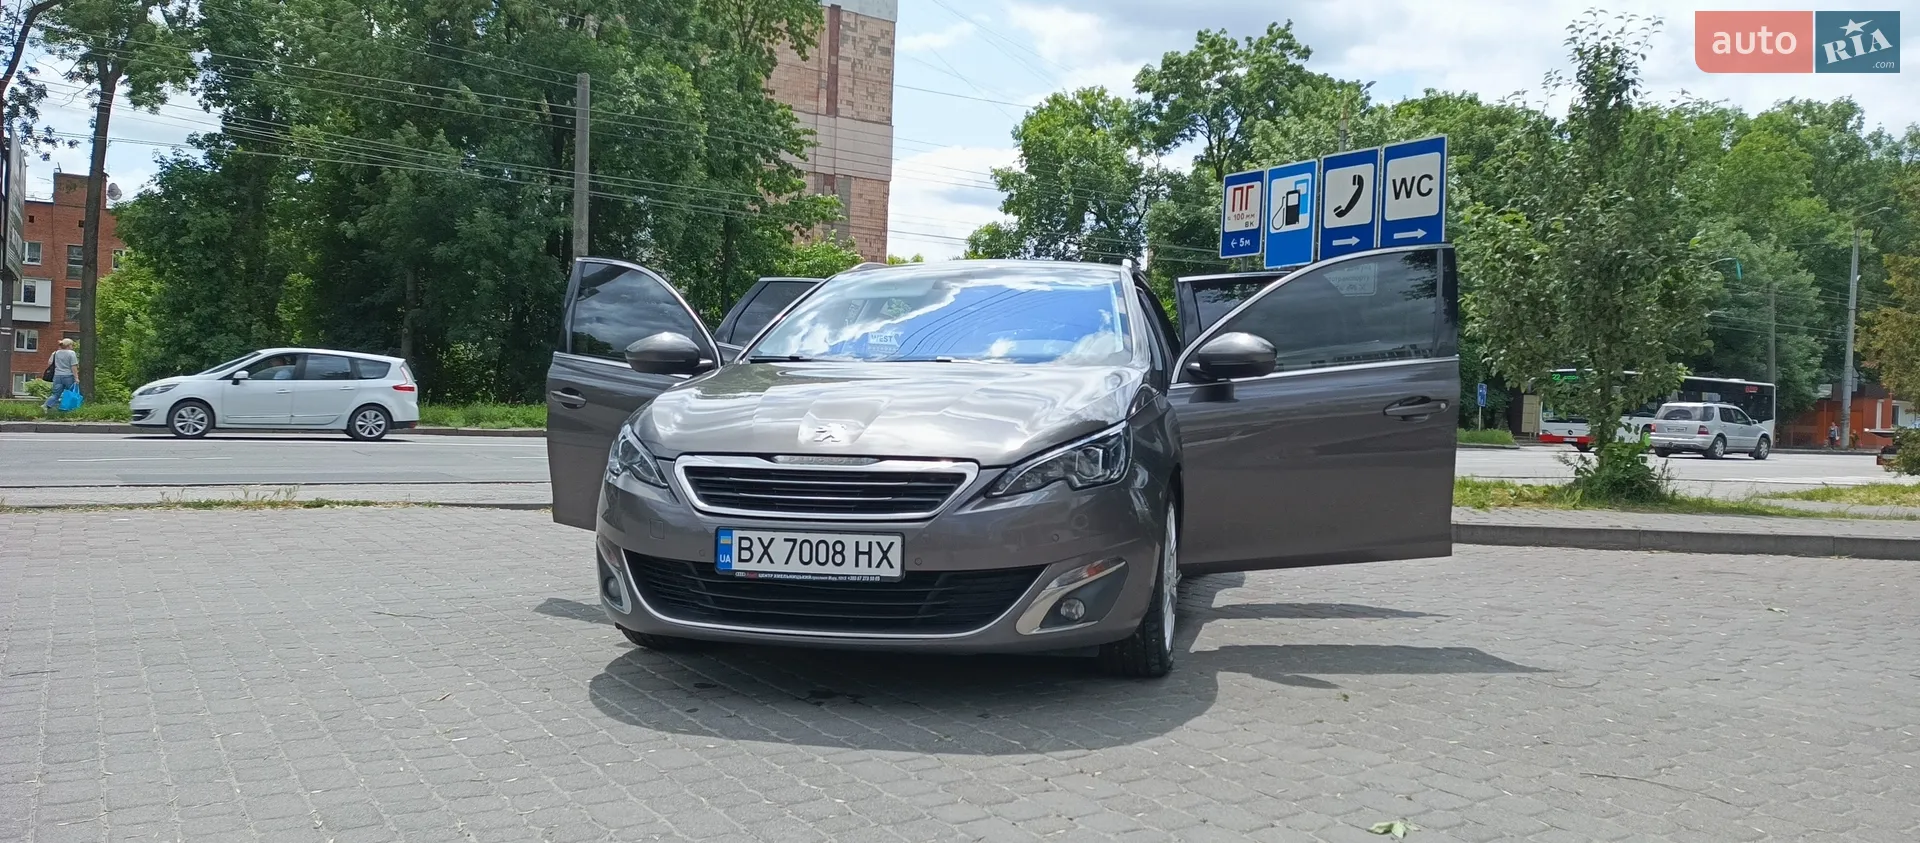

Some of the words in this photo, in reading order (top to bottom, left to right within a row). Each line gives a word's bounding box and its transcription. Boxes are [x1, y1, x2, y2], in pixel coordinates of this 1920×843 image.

[1232, 185, 1255, 212] ПГ
[1392, 173, 1434, 200] WC
[1233, 212, 1245, 221] 100
[719, 554, 732, 563] UA
[737, 536, 776, 564] BX
[783, 538, 846, 567] 7008
[854, 540, 895, 569] HX
